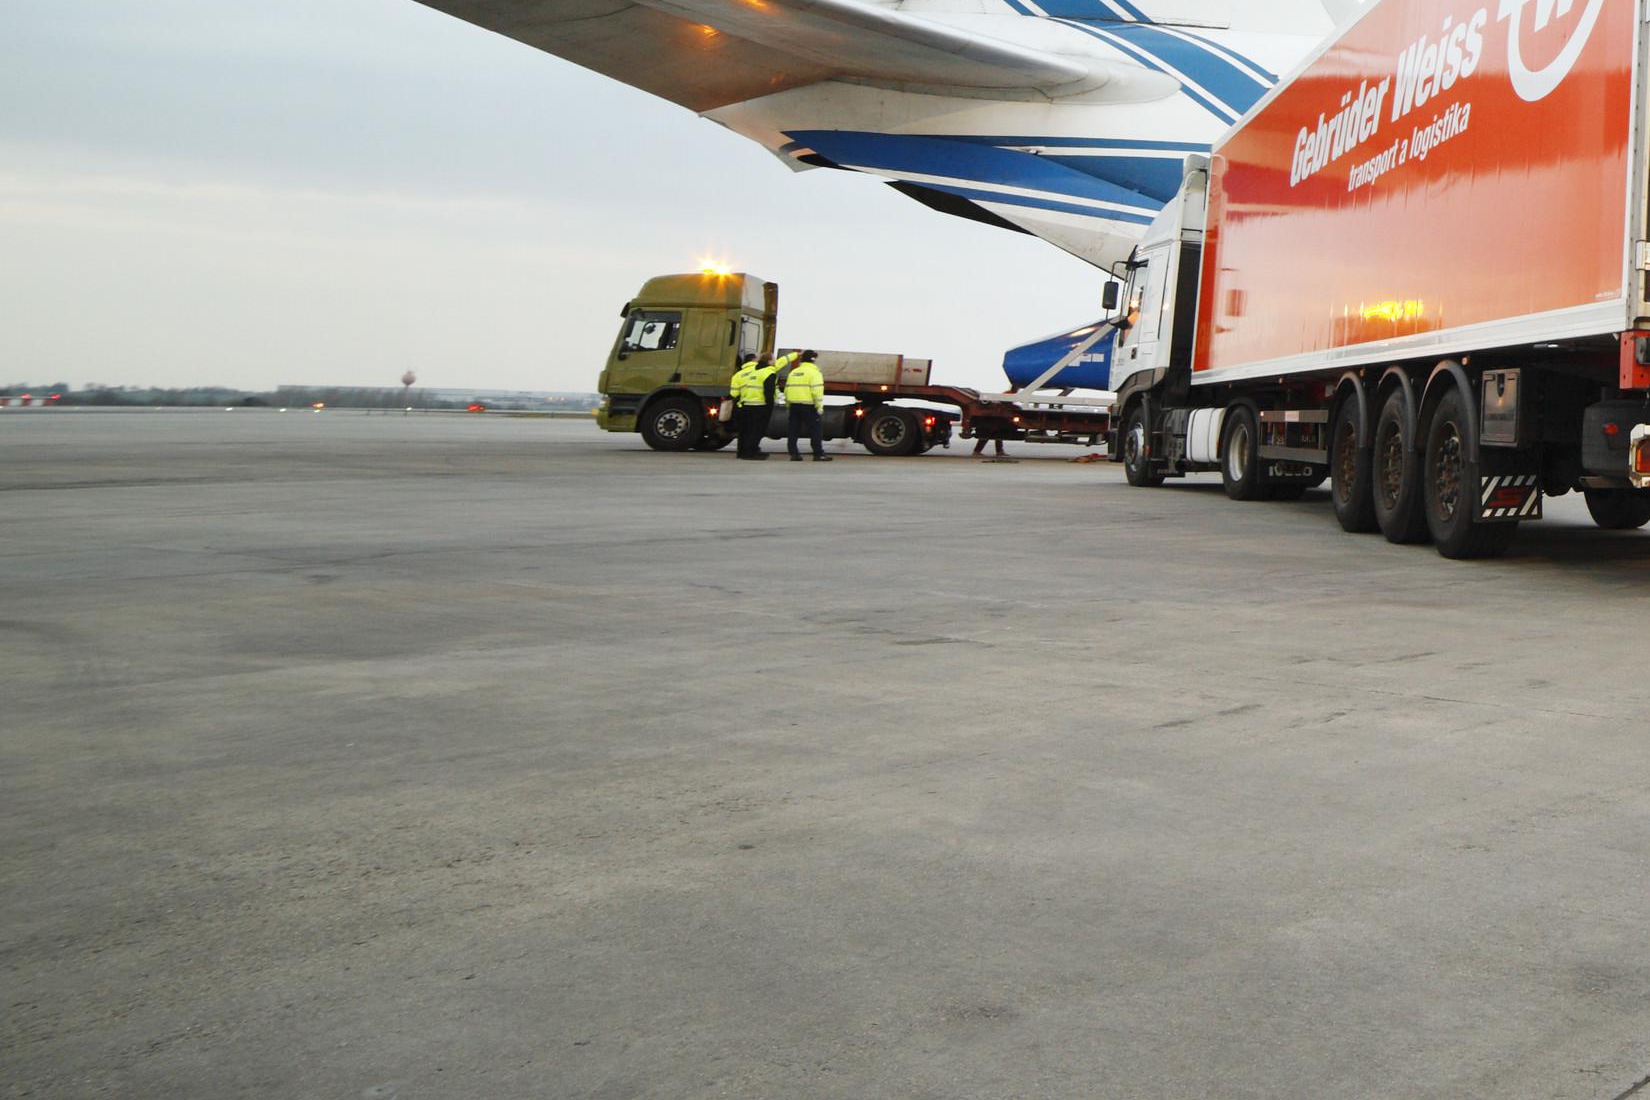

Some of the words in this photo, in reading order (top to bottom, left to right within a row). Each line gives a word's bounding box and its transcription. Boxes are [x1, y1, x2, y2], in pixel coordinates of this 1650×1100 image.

[1290, 74, 1390, 188] Gebrüder
[1391, 8, 1488, 122] Weiss
[1348, 138, 1399, 192] transport
[1399, 139, 1408, 165] a
[1409, 102, 1471, 161] logistika
